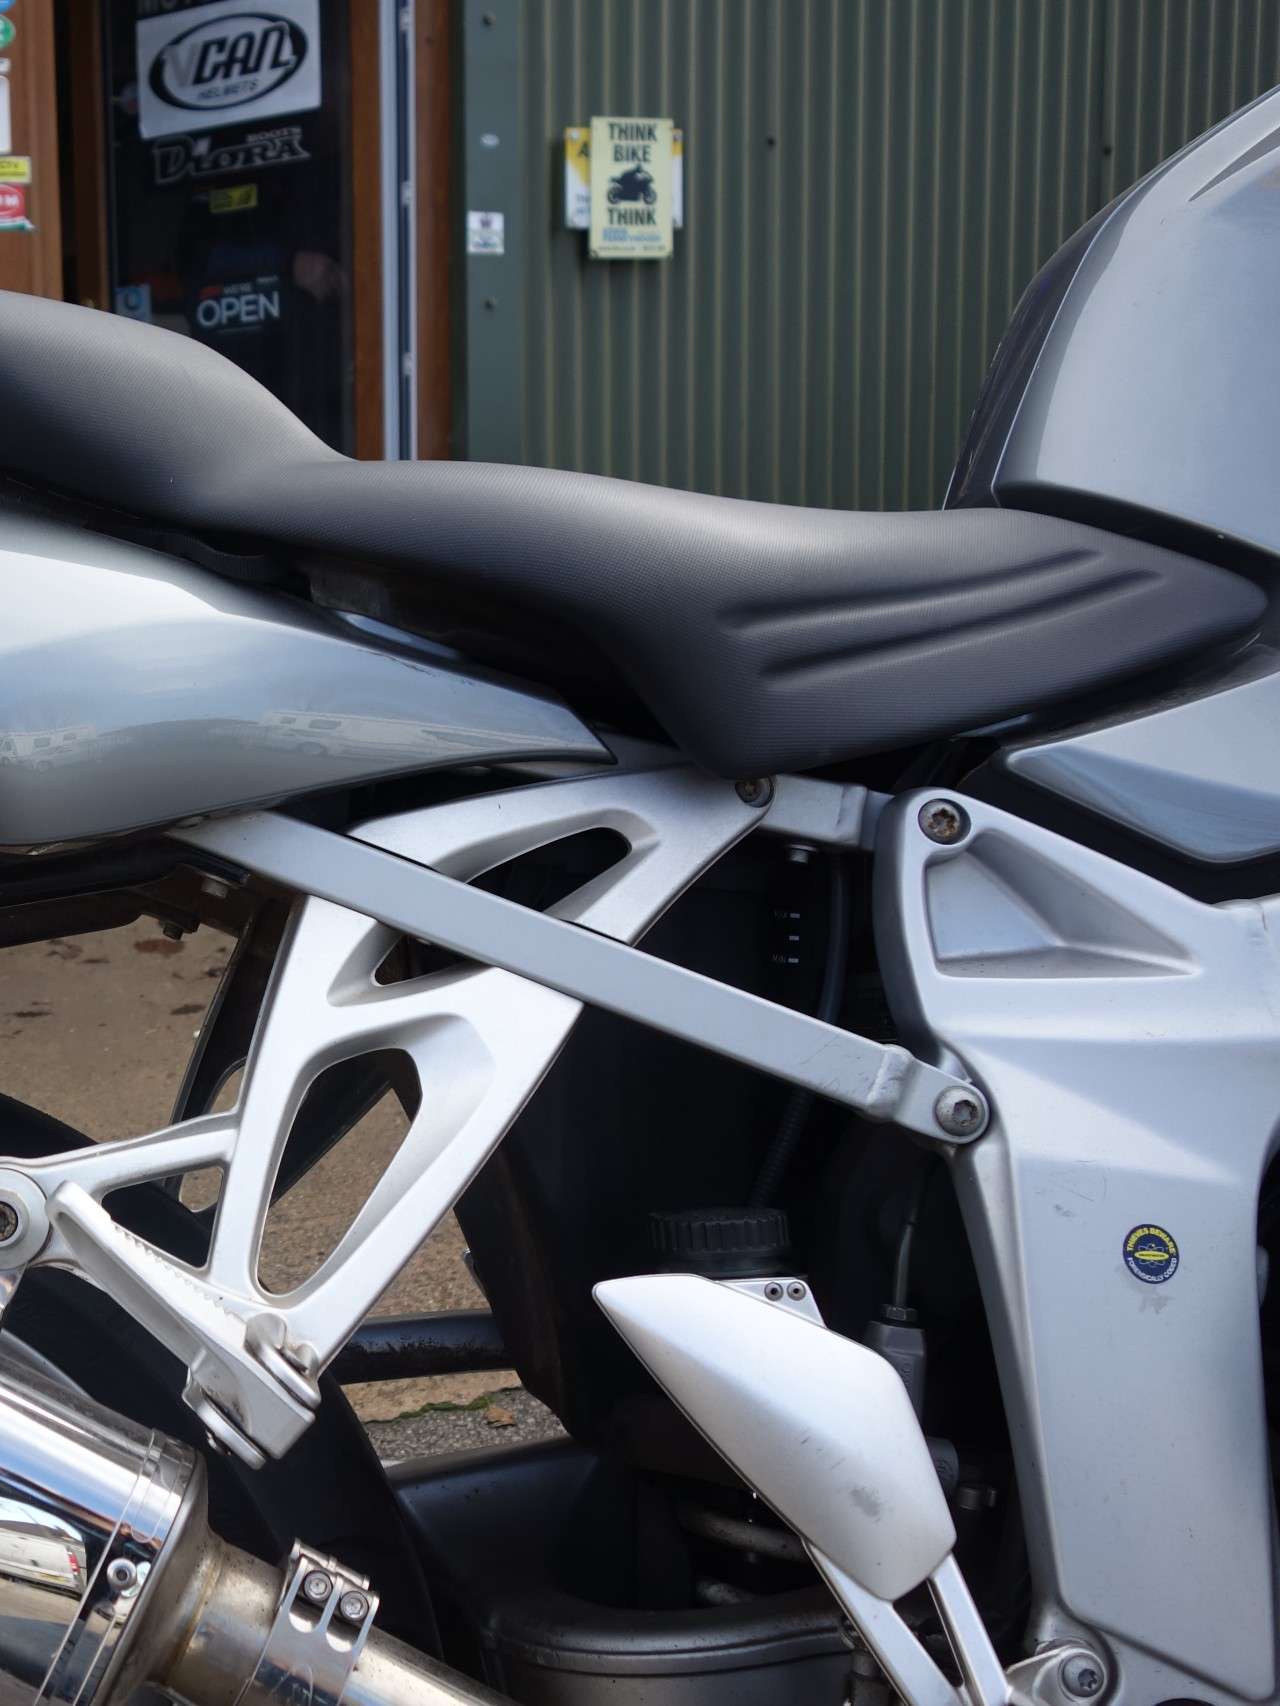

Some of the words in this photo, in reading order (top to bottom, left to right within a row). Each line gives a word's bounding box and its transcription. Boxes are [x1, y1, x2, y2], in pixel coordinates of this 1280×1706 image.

[608, 123, 658, 142] THINK
[614, 144, 651, 162] BIKE
[608, 207, 657, 226] THINK
[196, 291, 281, 327] OPEN
[1163, 1257, 1177, 1278] CODED
